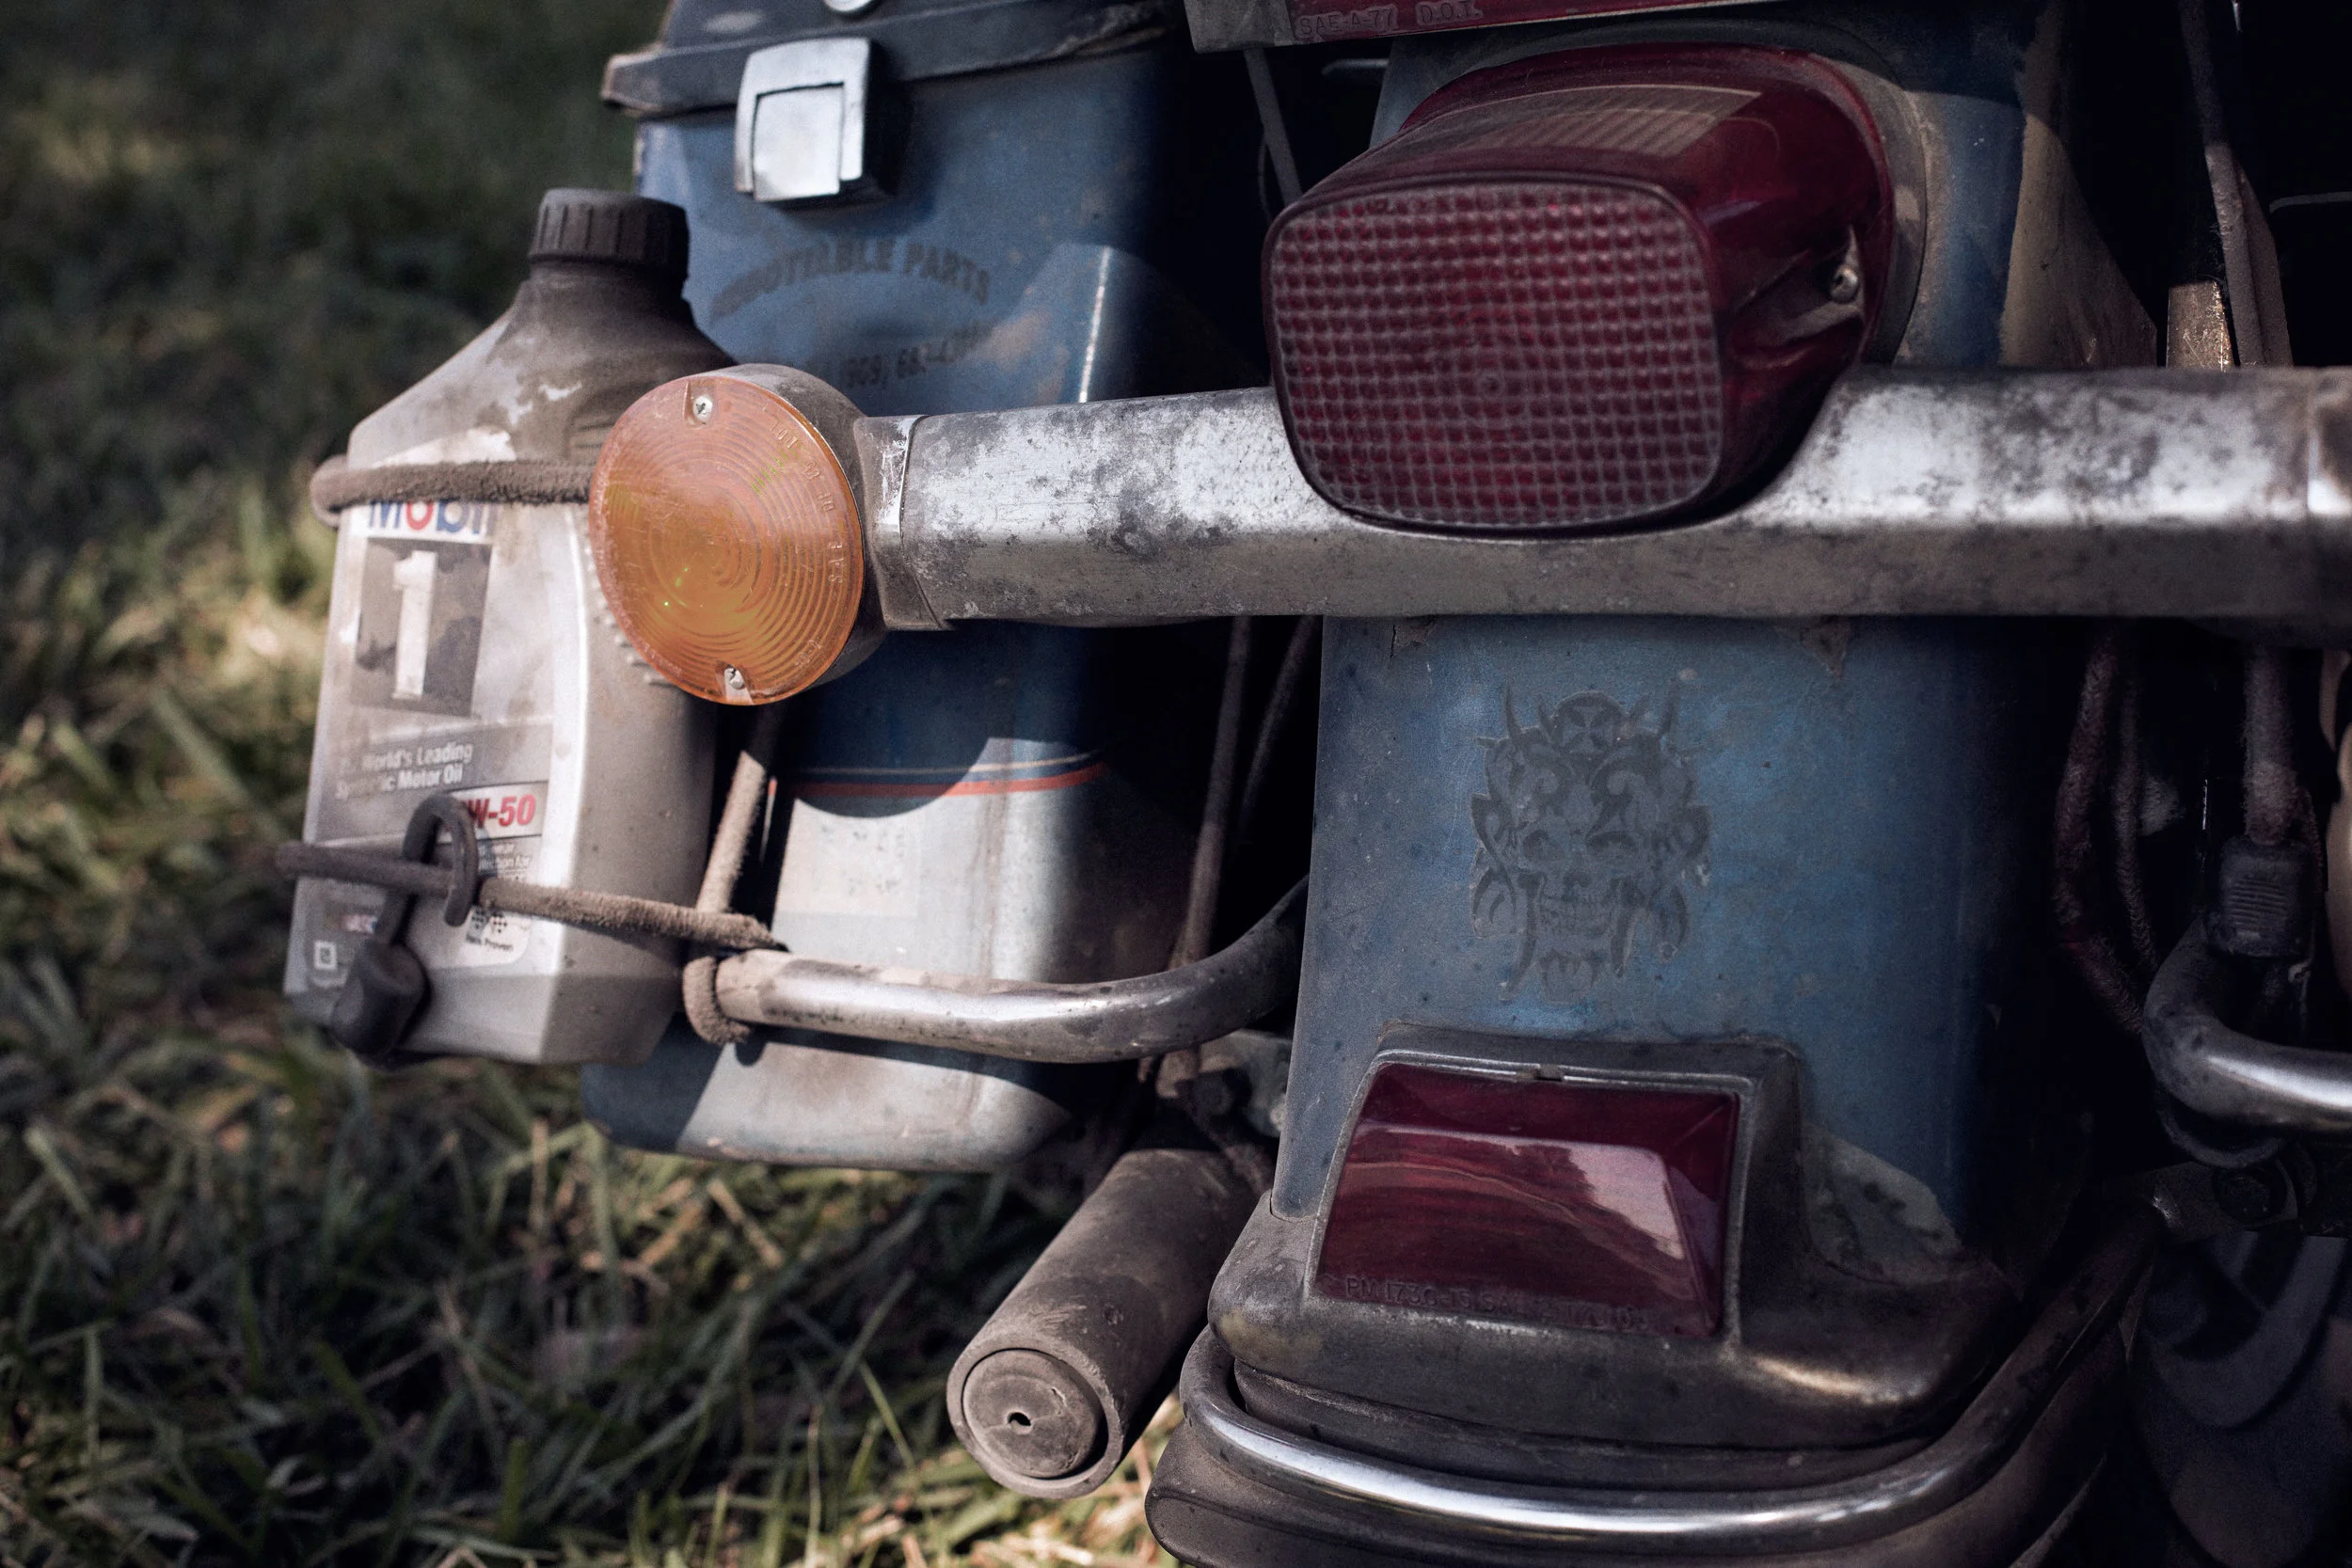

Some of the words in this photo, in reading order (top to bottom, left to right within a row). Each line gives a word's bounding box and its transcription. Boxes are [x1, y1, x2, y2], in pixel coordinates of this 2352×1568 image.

[417, 740, 473, 767] Leading
[397, 769, 440, 790] Motor
[442, 762, 464, 785] Oil
[461, 793, 536, 828] W-50
